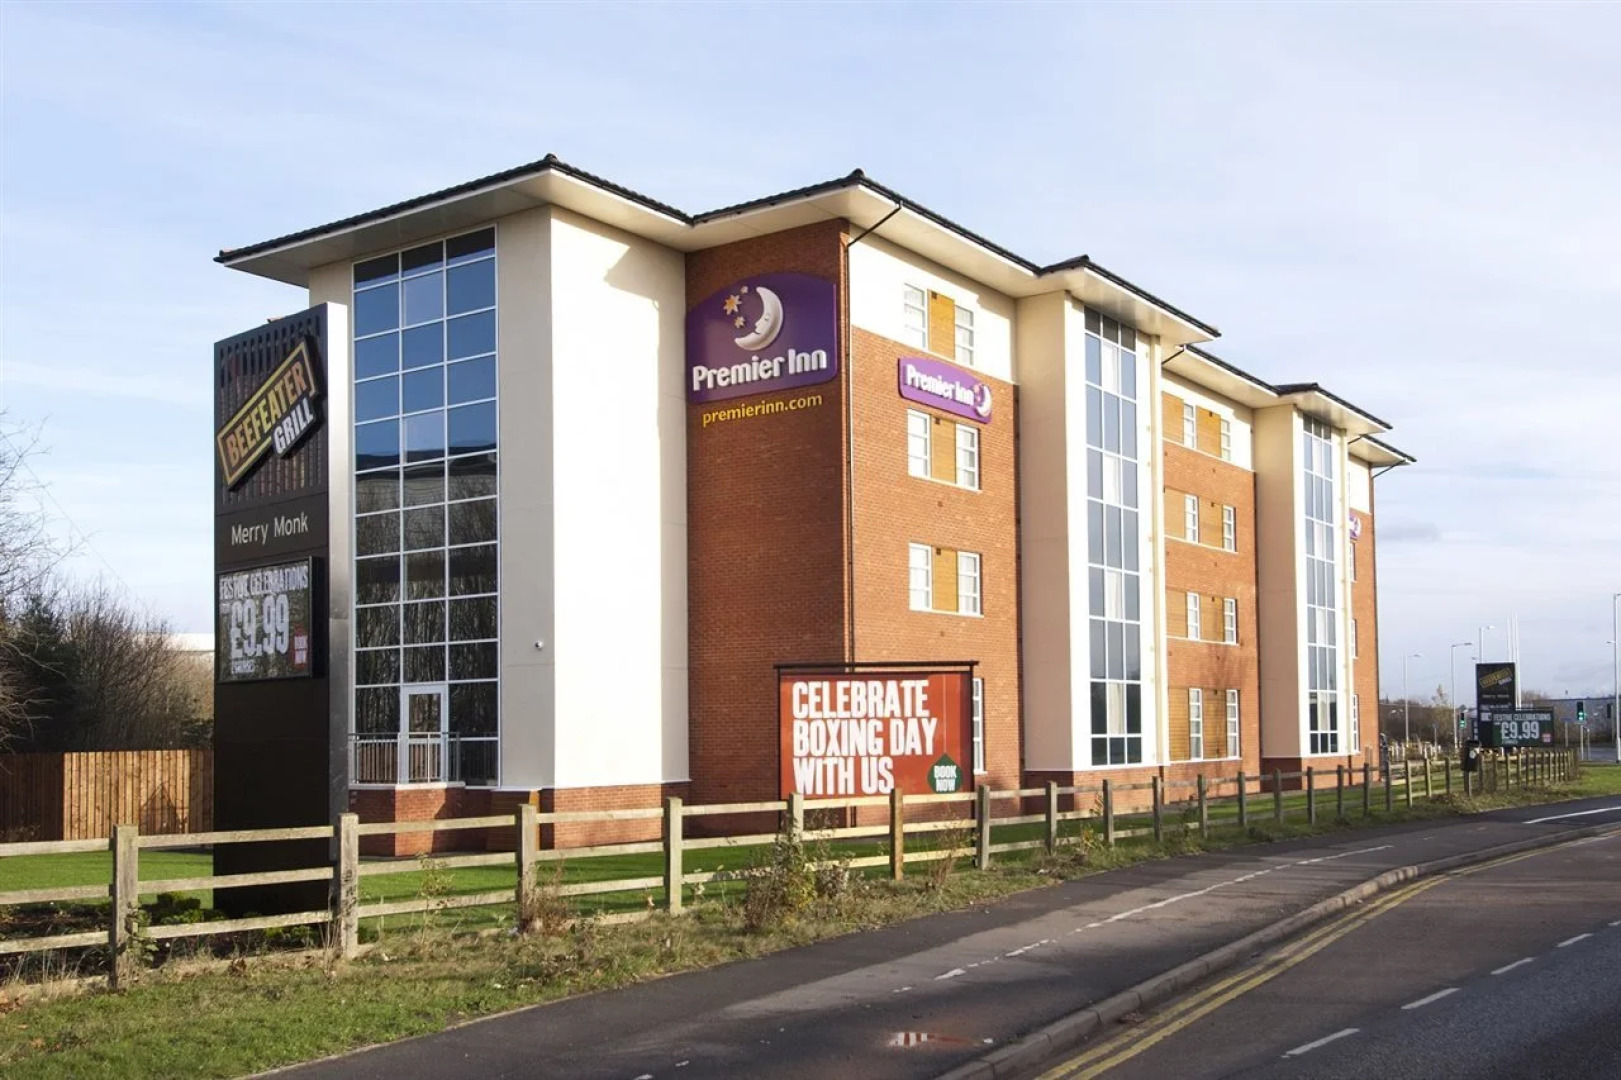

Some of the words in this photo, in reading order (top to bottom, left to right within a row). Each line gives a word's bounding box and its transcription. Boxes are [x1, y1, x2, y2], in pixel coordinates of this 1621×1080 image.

[692, 355, 786, 391] Premier
[788, 348, 828, 375] Inn
[906, 364, 955, 400] Premier
[955, 381, 975, 406] Inn
[225, 360, 308, 468] BEEFEATER
[273, 397, 314, 455] GRILL
[702, 394, 823, 427] premierinn.com
[231, 523, 269, 546] Merry
[274, 511, 309, 538] Monk
[230, 594, 290, 658] £9.99
[792, 679, 931, 719] CELEBRATE
[792, 718, 885, 757] BOXING
[889, 717, 938, 756] DAY
[1501, 721, 1540, 739] £9.99
[793, 756, 855, 795] WITH
[860, 756, 895, 795] US
[933, 765, 957, 778] BOOK
[935, 778, 956, 792] NOW
